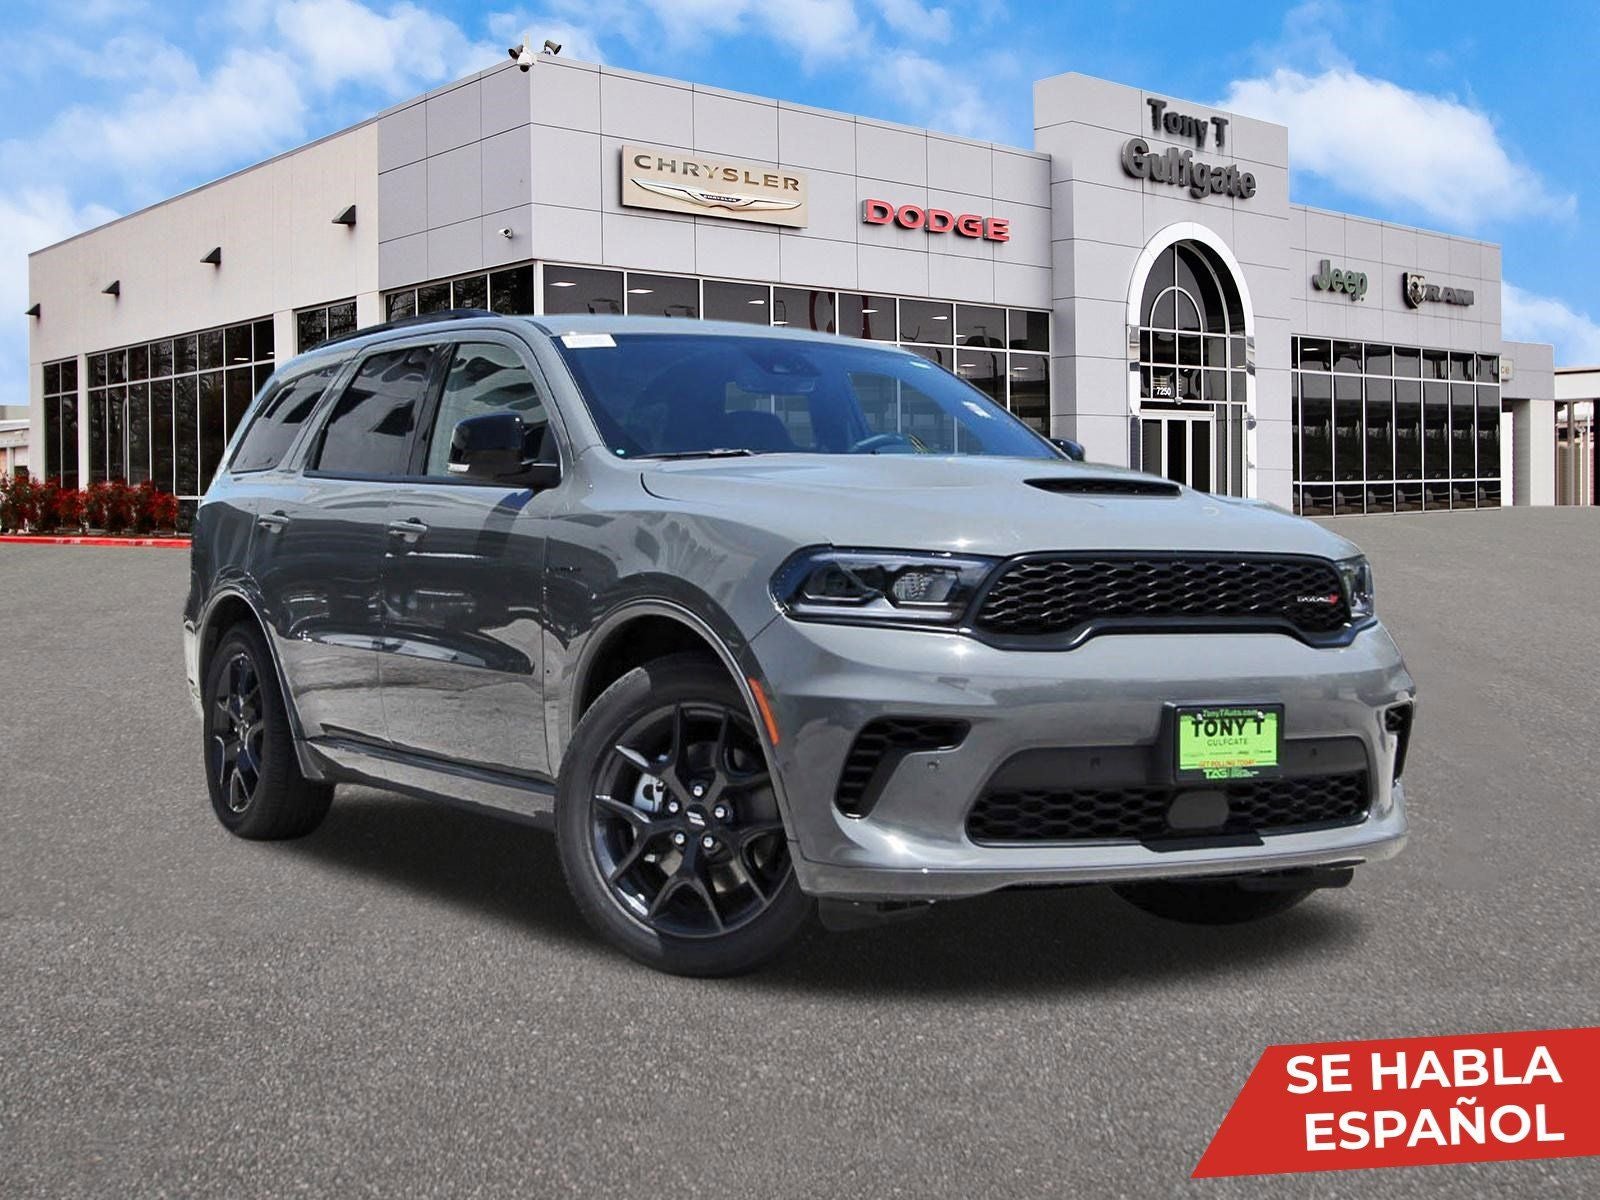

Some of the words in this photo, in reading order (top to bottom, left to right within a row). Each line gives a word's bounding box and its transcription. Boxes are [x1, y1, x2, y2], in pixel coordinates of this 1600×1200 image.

[1147, 98, 1208, 148] Tony
[1211, 117, 1229, 147] T
[633, 153, 801, 192] CHRYSLER
[1121, 138, 1257, 199] Gulfgate
[862, 198, 1011, 243] DODGE
[1312, 259, 1368, 302] Jeep
[1425, 284, 1475, 306] RAM
[1156, 387, 1172, 396] 7250
[1191, 718, 1248, 737] TONY
[1253, 717, 1265, 735] T
[1207, 738, 1248, 746] GULFGATE
